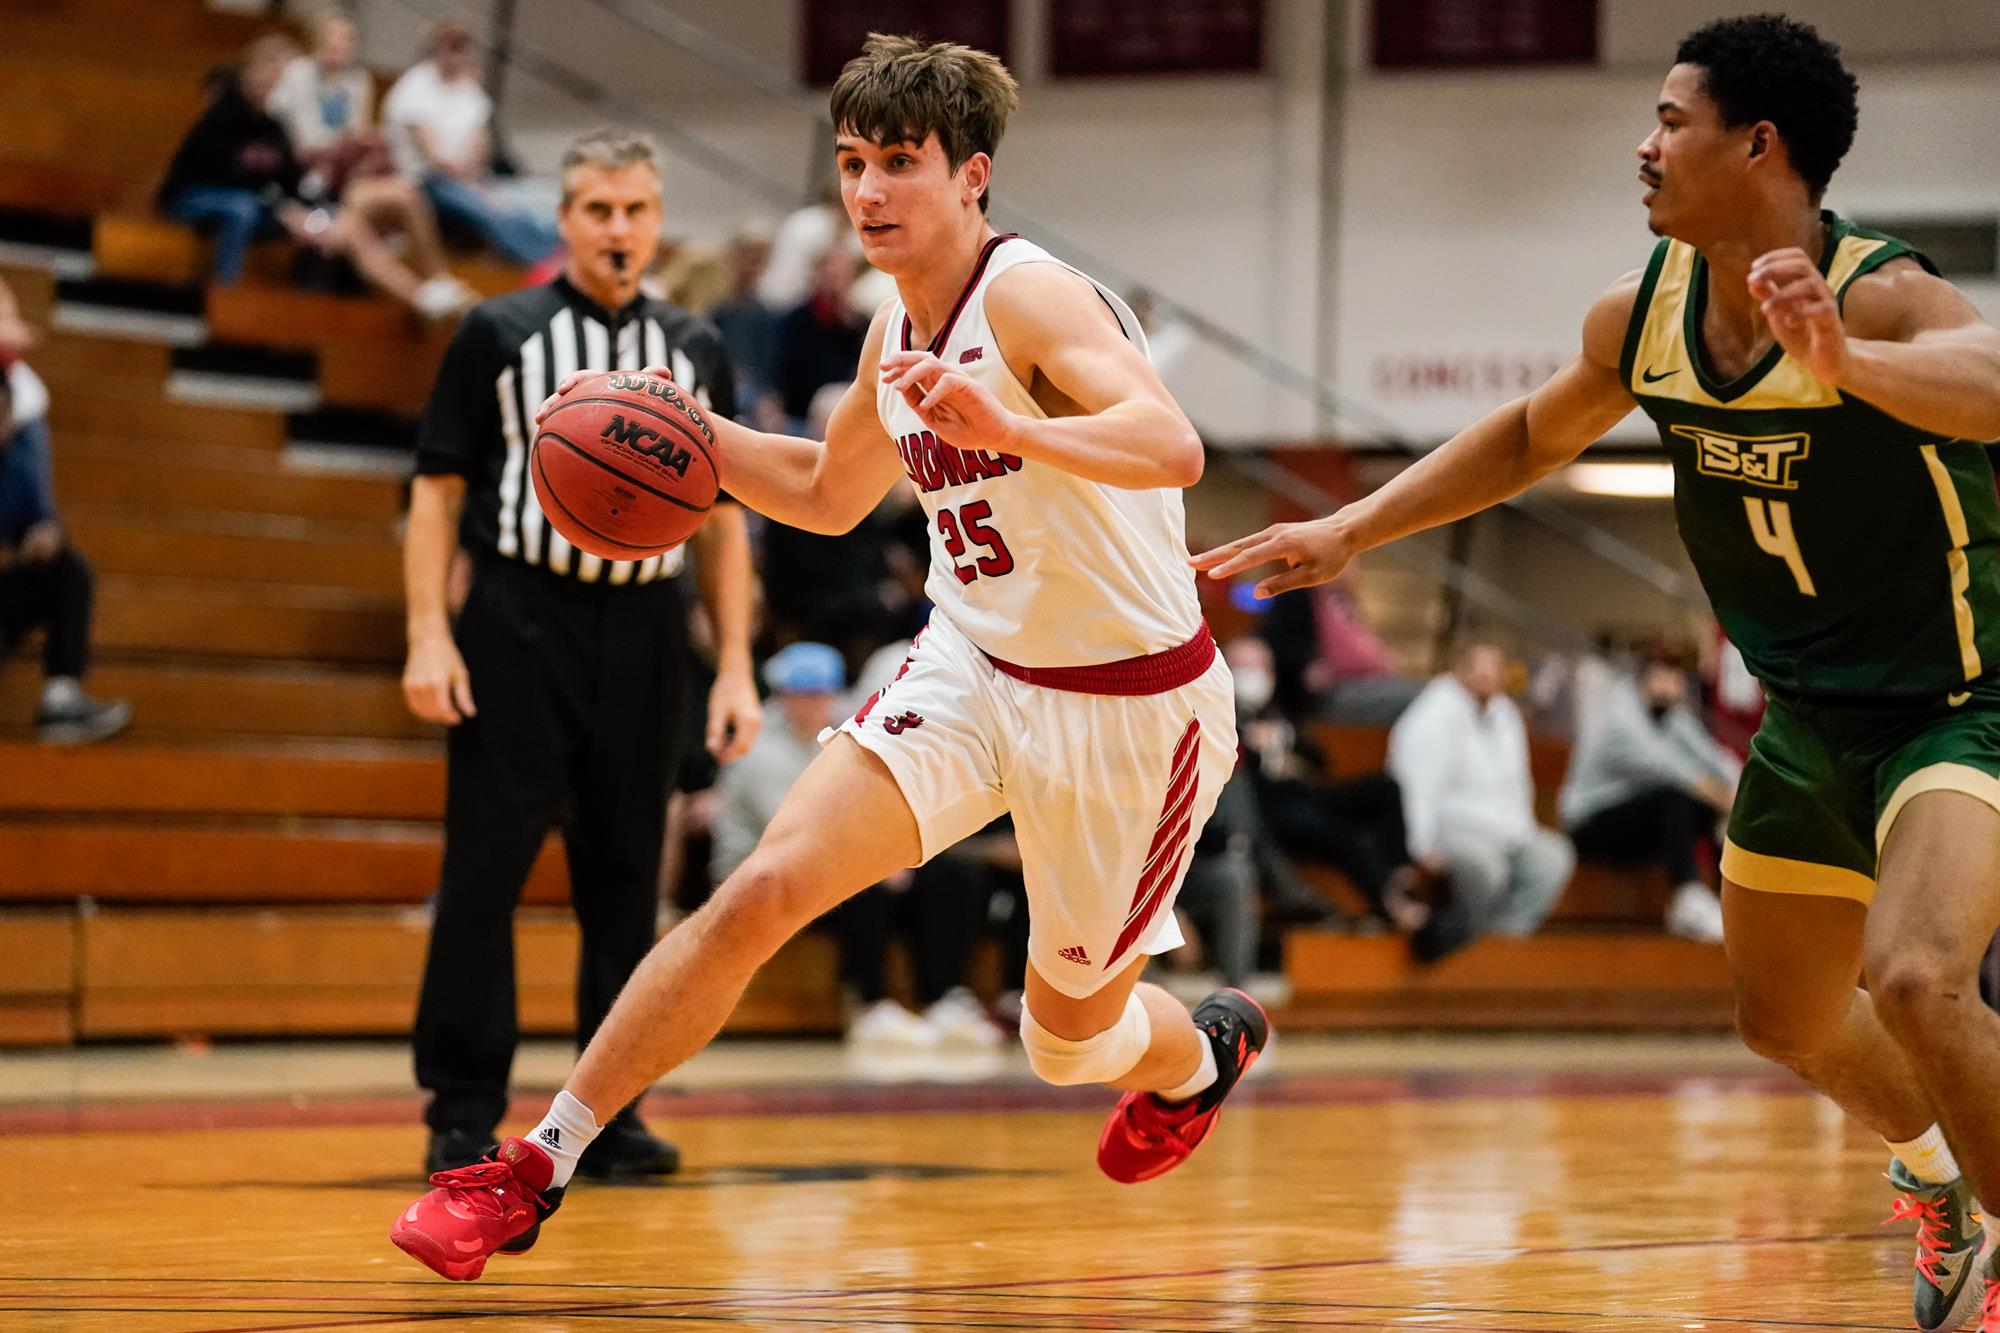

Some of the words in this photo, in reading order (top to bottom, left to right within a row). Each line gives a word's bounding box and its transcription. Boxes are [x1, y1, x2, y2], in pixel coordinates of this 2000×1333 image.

[600, 415, 692, 478] NCAA
[608, 374, 715, 447] Wilson
[1691, 431, 1800, 483] S&T
[937, 499, 1014, 586] 25
[1742, 496, 1818, 597] 4
